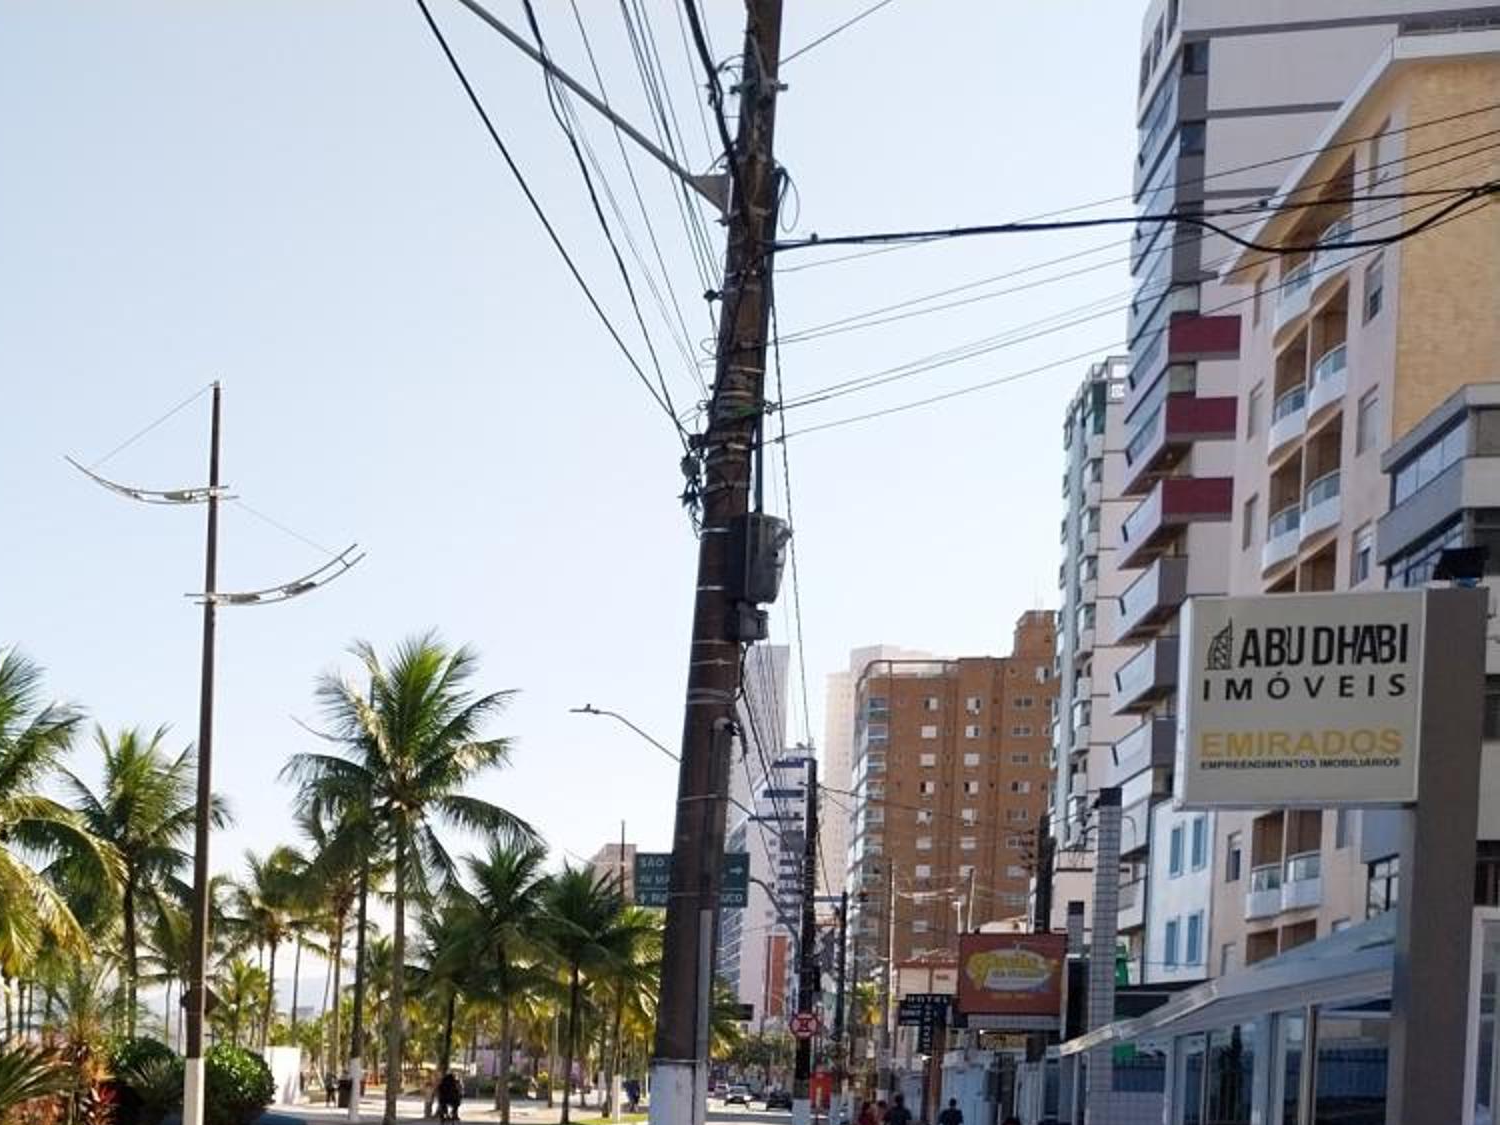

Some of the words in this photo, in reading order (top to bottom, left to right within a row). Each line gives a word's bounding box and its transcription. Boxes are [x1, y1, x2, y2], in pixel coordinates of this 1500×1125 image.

[1238, 625, 1304, 668] ABU
[1312, 623, 1408, 666] DHABI
[1203, 672, 1405, 701] IMÓVEIS
[1201, 728, 1402, 757] EMIRADOS
[1201, 759, 1317, 770] EMPREENDIMENTOS
